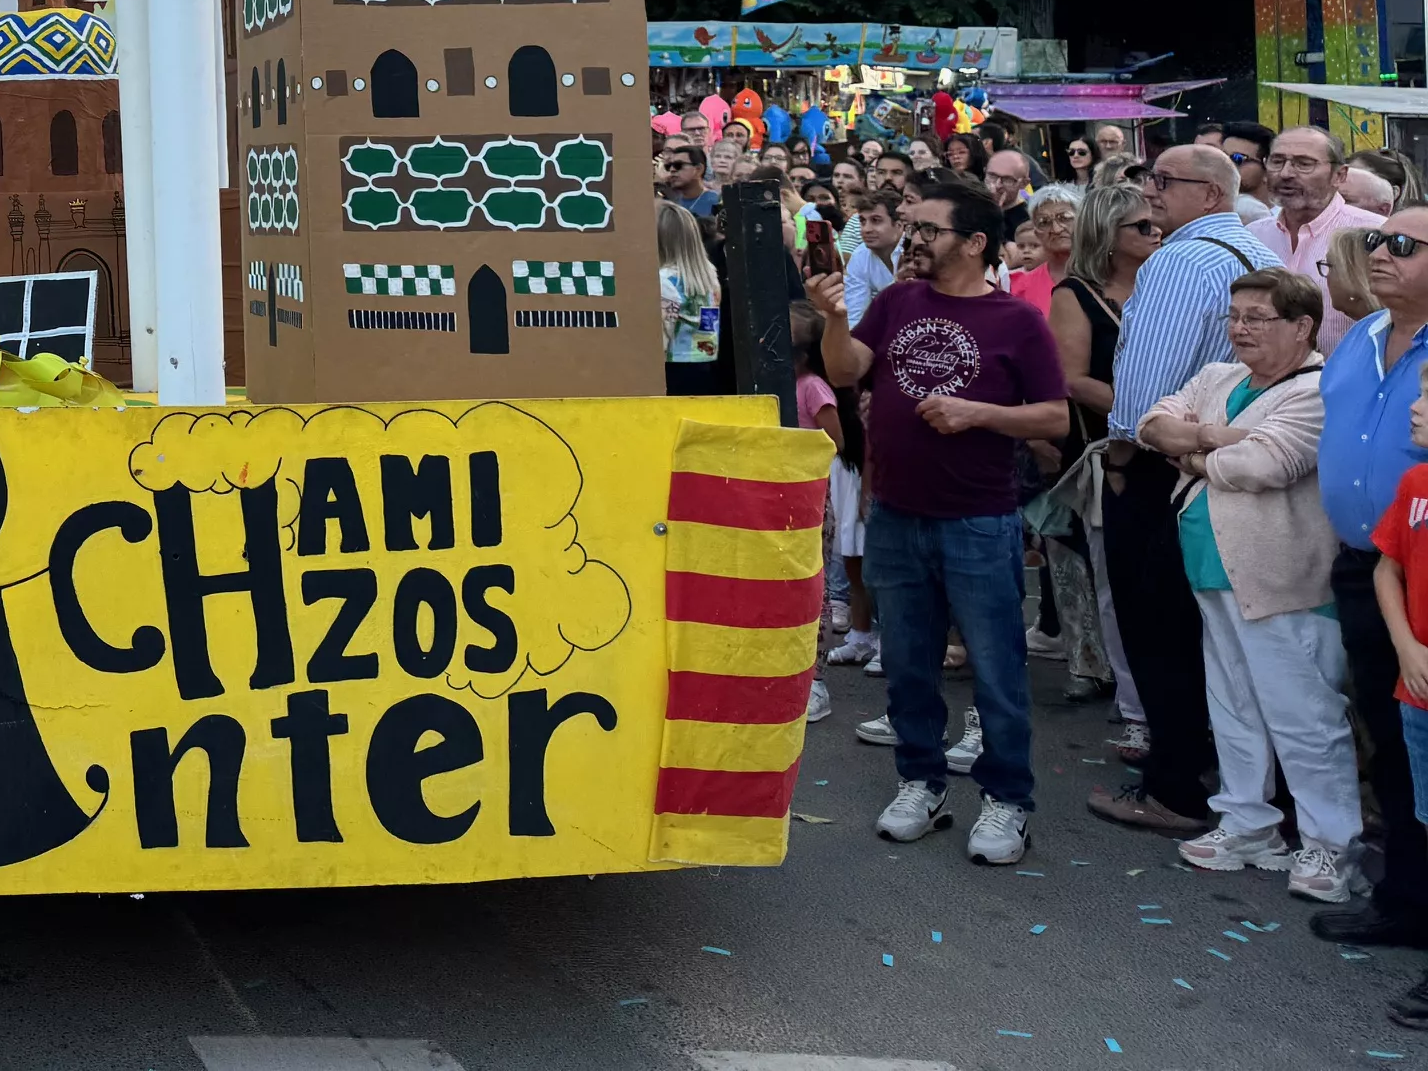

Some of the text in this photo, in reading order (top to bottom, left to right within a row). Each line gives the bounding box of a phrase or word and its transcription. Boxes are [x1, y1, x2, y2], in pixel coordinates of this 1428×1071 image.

[892, 322, 937, 356] URBAN
[940, 323, 975, 367] STREET
[894, 367, 927, 398] STYLE
